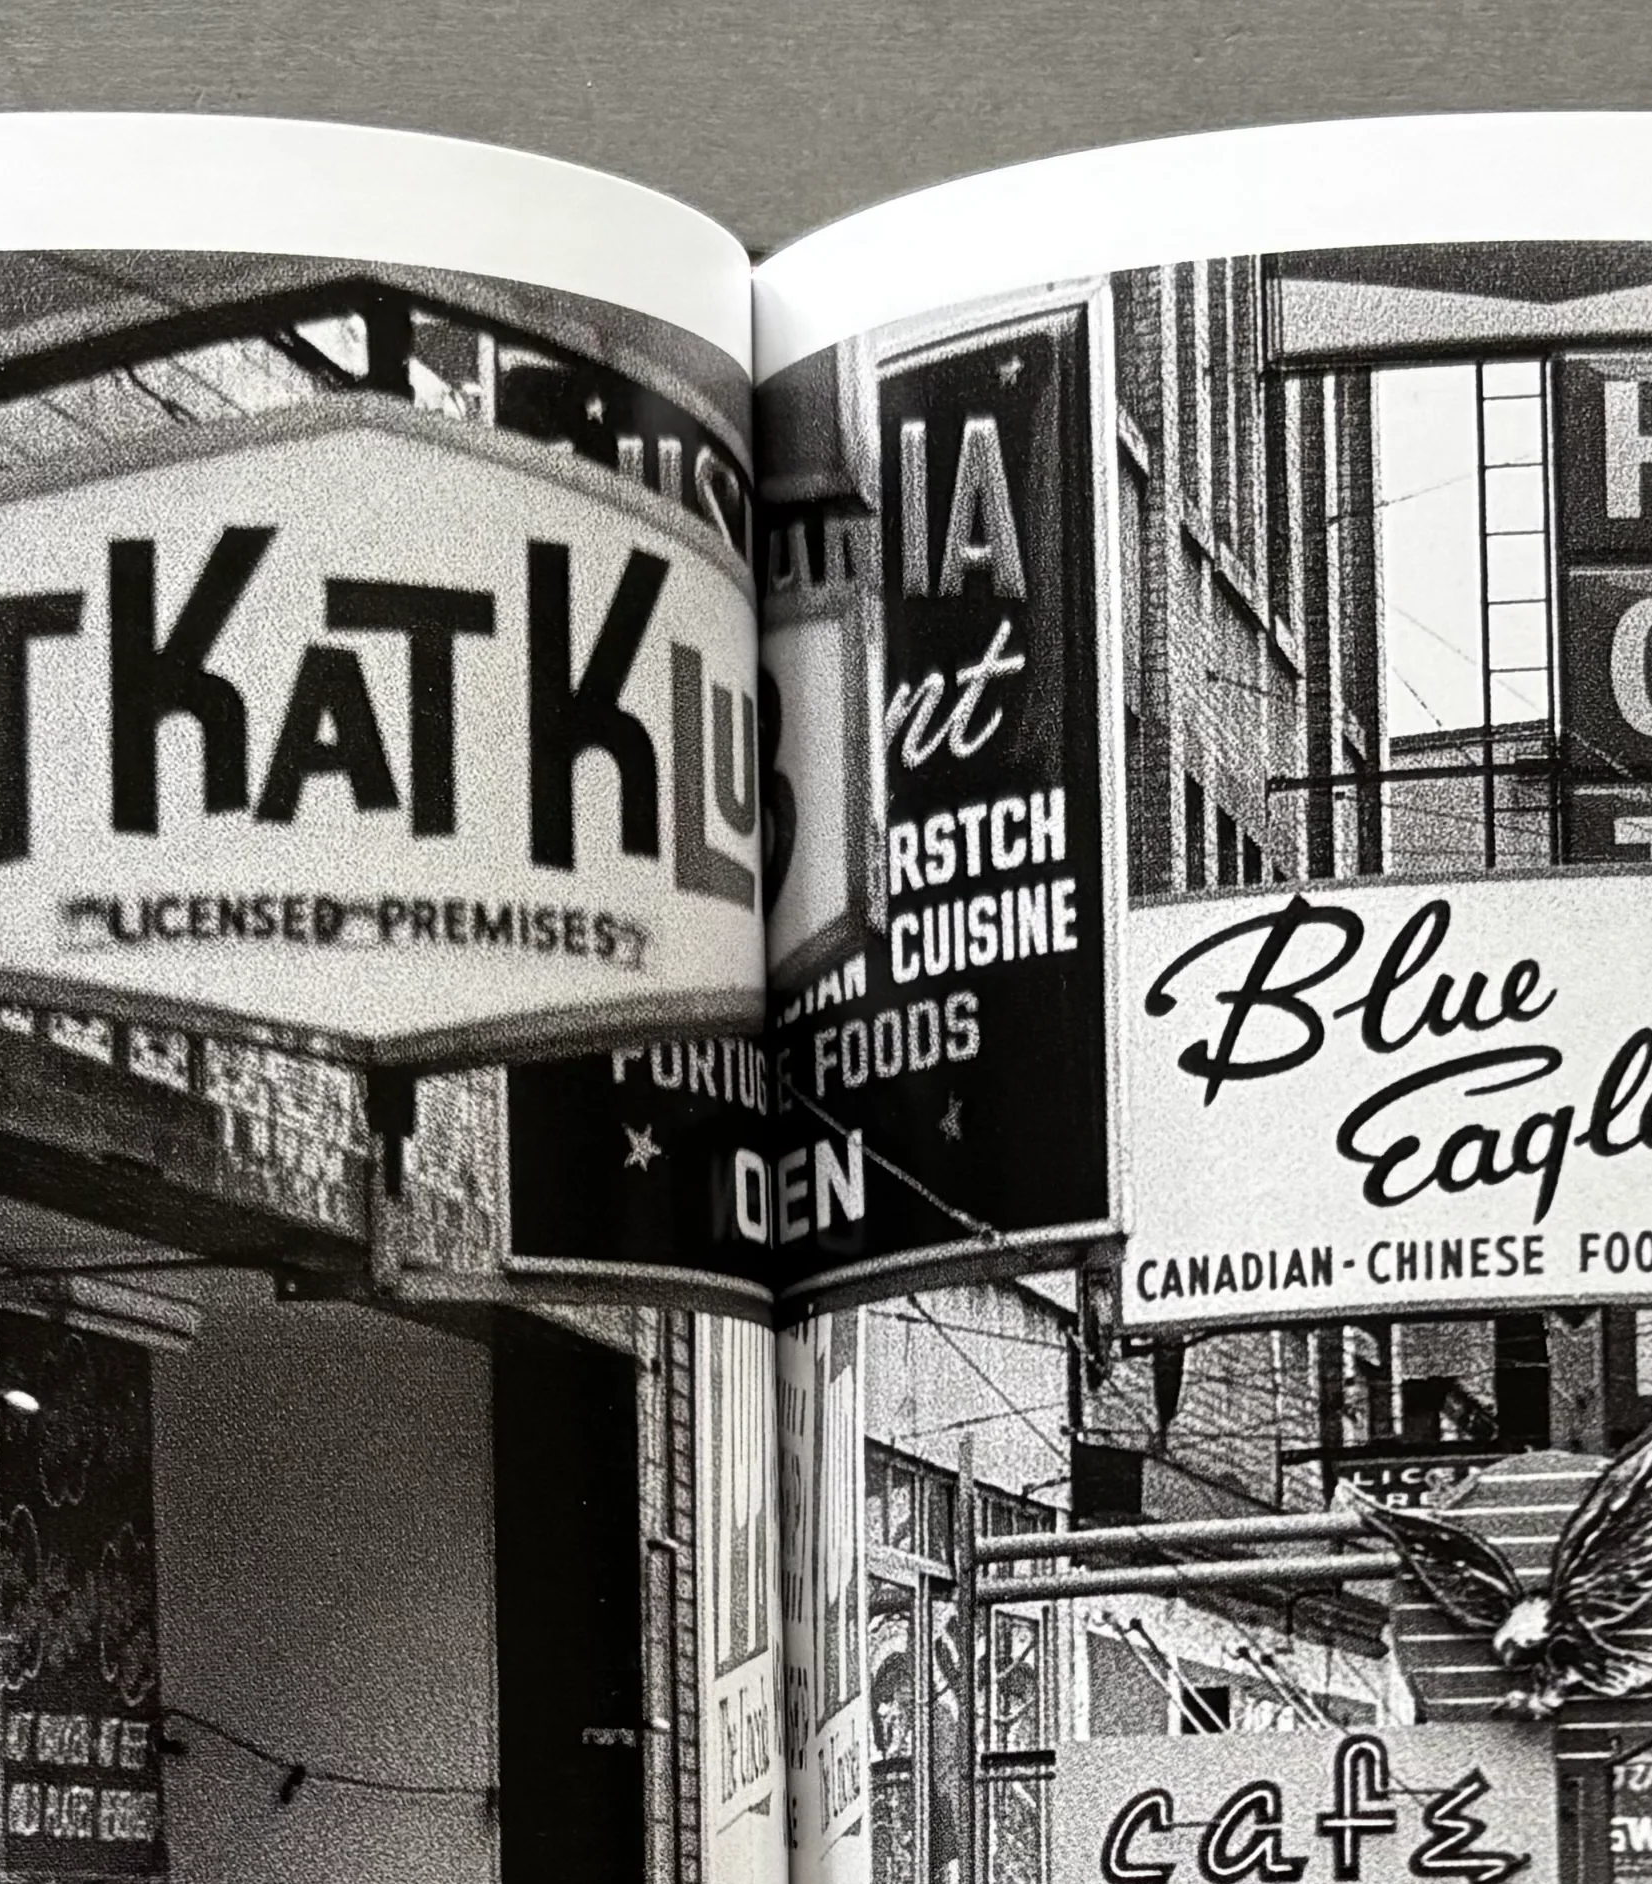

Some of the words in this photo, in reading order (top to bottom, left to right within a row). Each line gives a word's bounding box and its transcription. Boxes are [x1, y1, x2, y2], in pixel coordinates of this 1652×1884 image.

[109, 524, 496, 836] KAT
[888, 878, 1079, 985] CUISINE
[1145, 894, 1558, 1106] Blue
[813, 992, 981, 1099] FOODS
